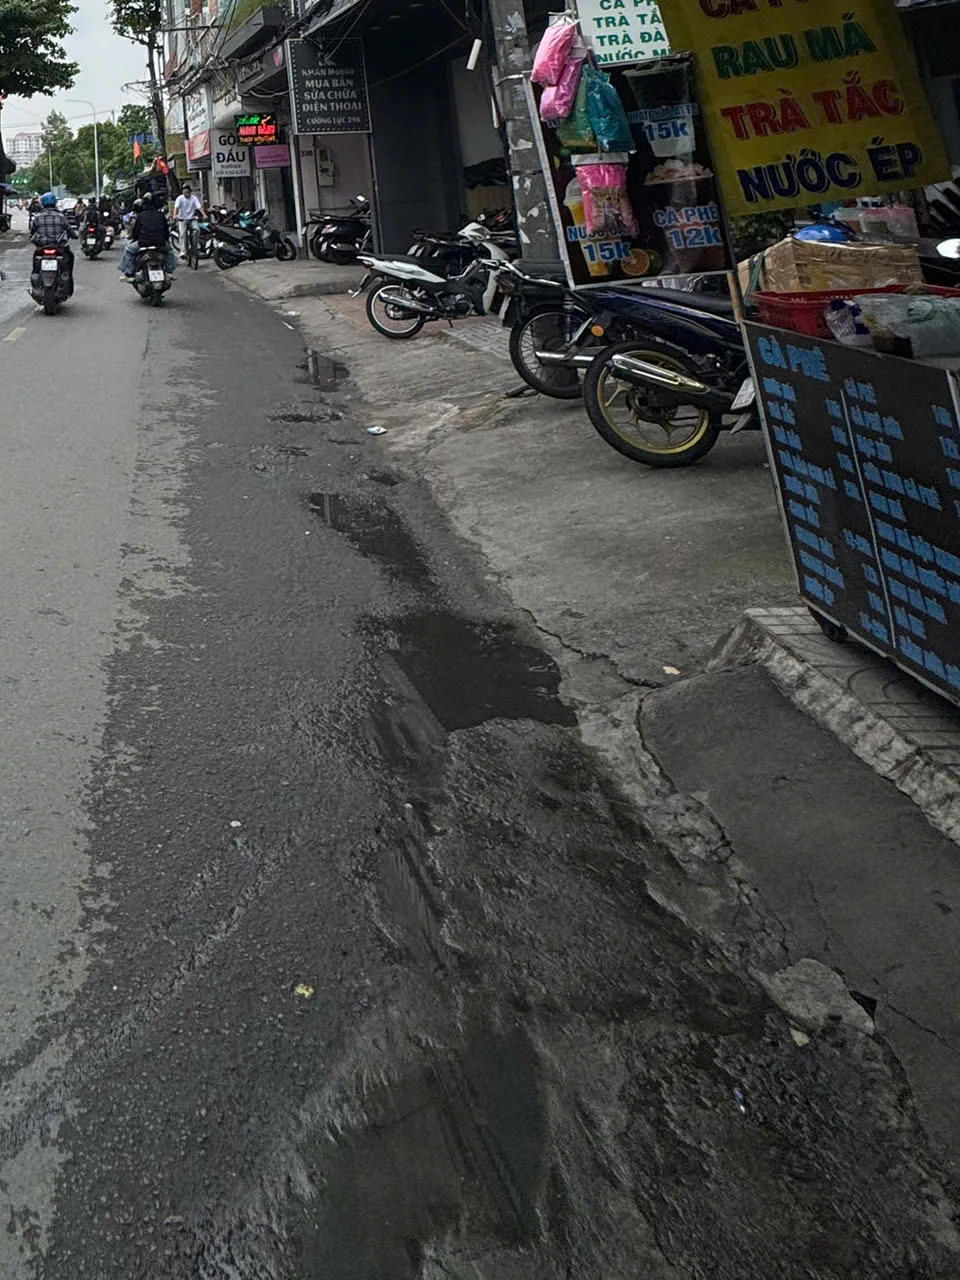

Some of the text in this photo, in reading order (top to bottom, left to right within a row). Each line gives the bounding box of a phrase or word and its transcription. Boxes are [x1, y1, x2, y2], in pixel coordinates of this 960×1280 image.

[592, 7, 663, 28] TRÀ TẮ
[596, 26, 666, 47] TRÀ ĐÀ
[711, 11, 879, 80] RAU MÁ
[305, 79, 330, 88] MUA
[721, 70, 905, 141] TRÀ TẮC
[643, 120, 690, 141] 15k
[736, 136, 923, 204] NƯỚC ÉP
[653, 206, 681, 227] CÀ
[668, 226, 720, 248] 12k
[583, 240, 631, 262] 15k
